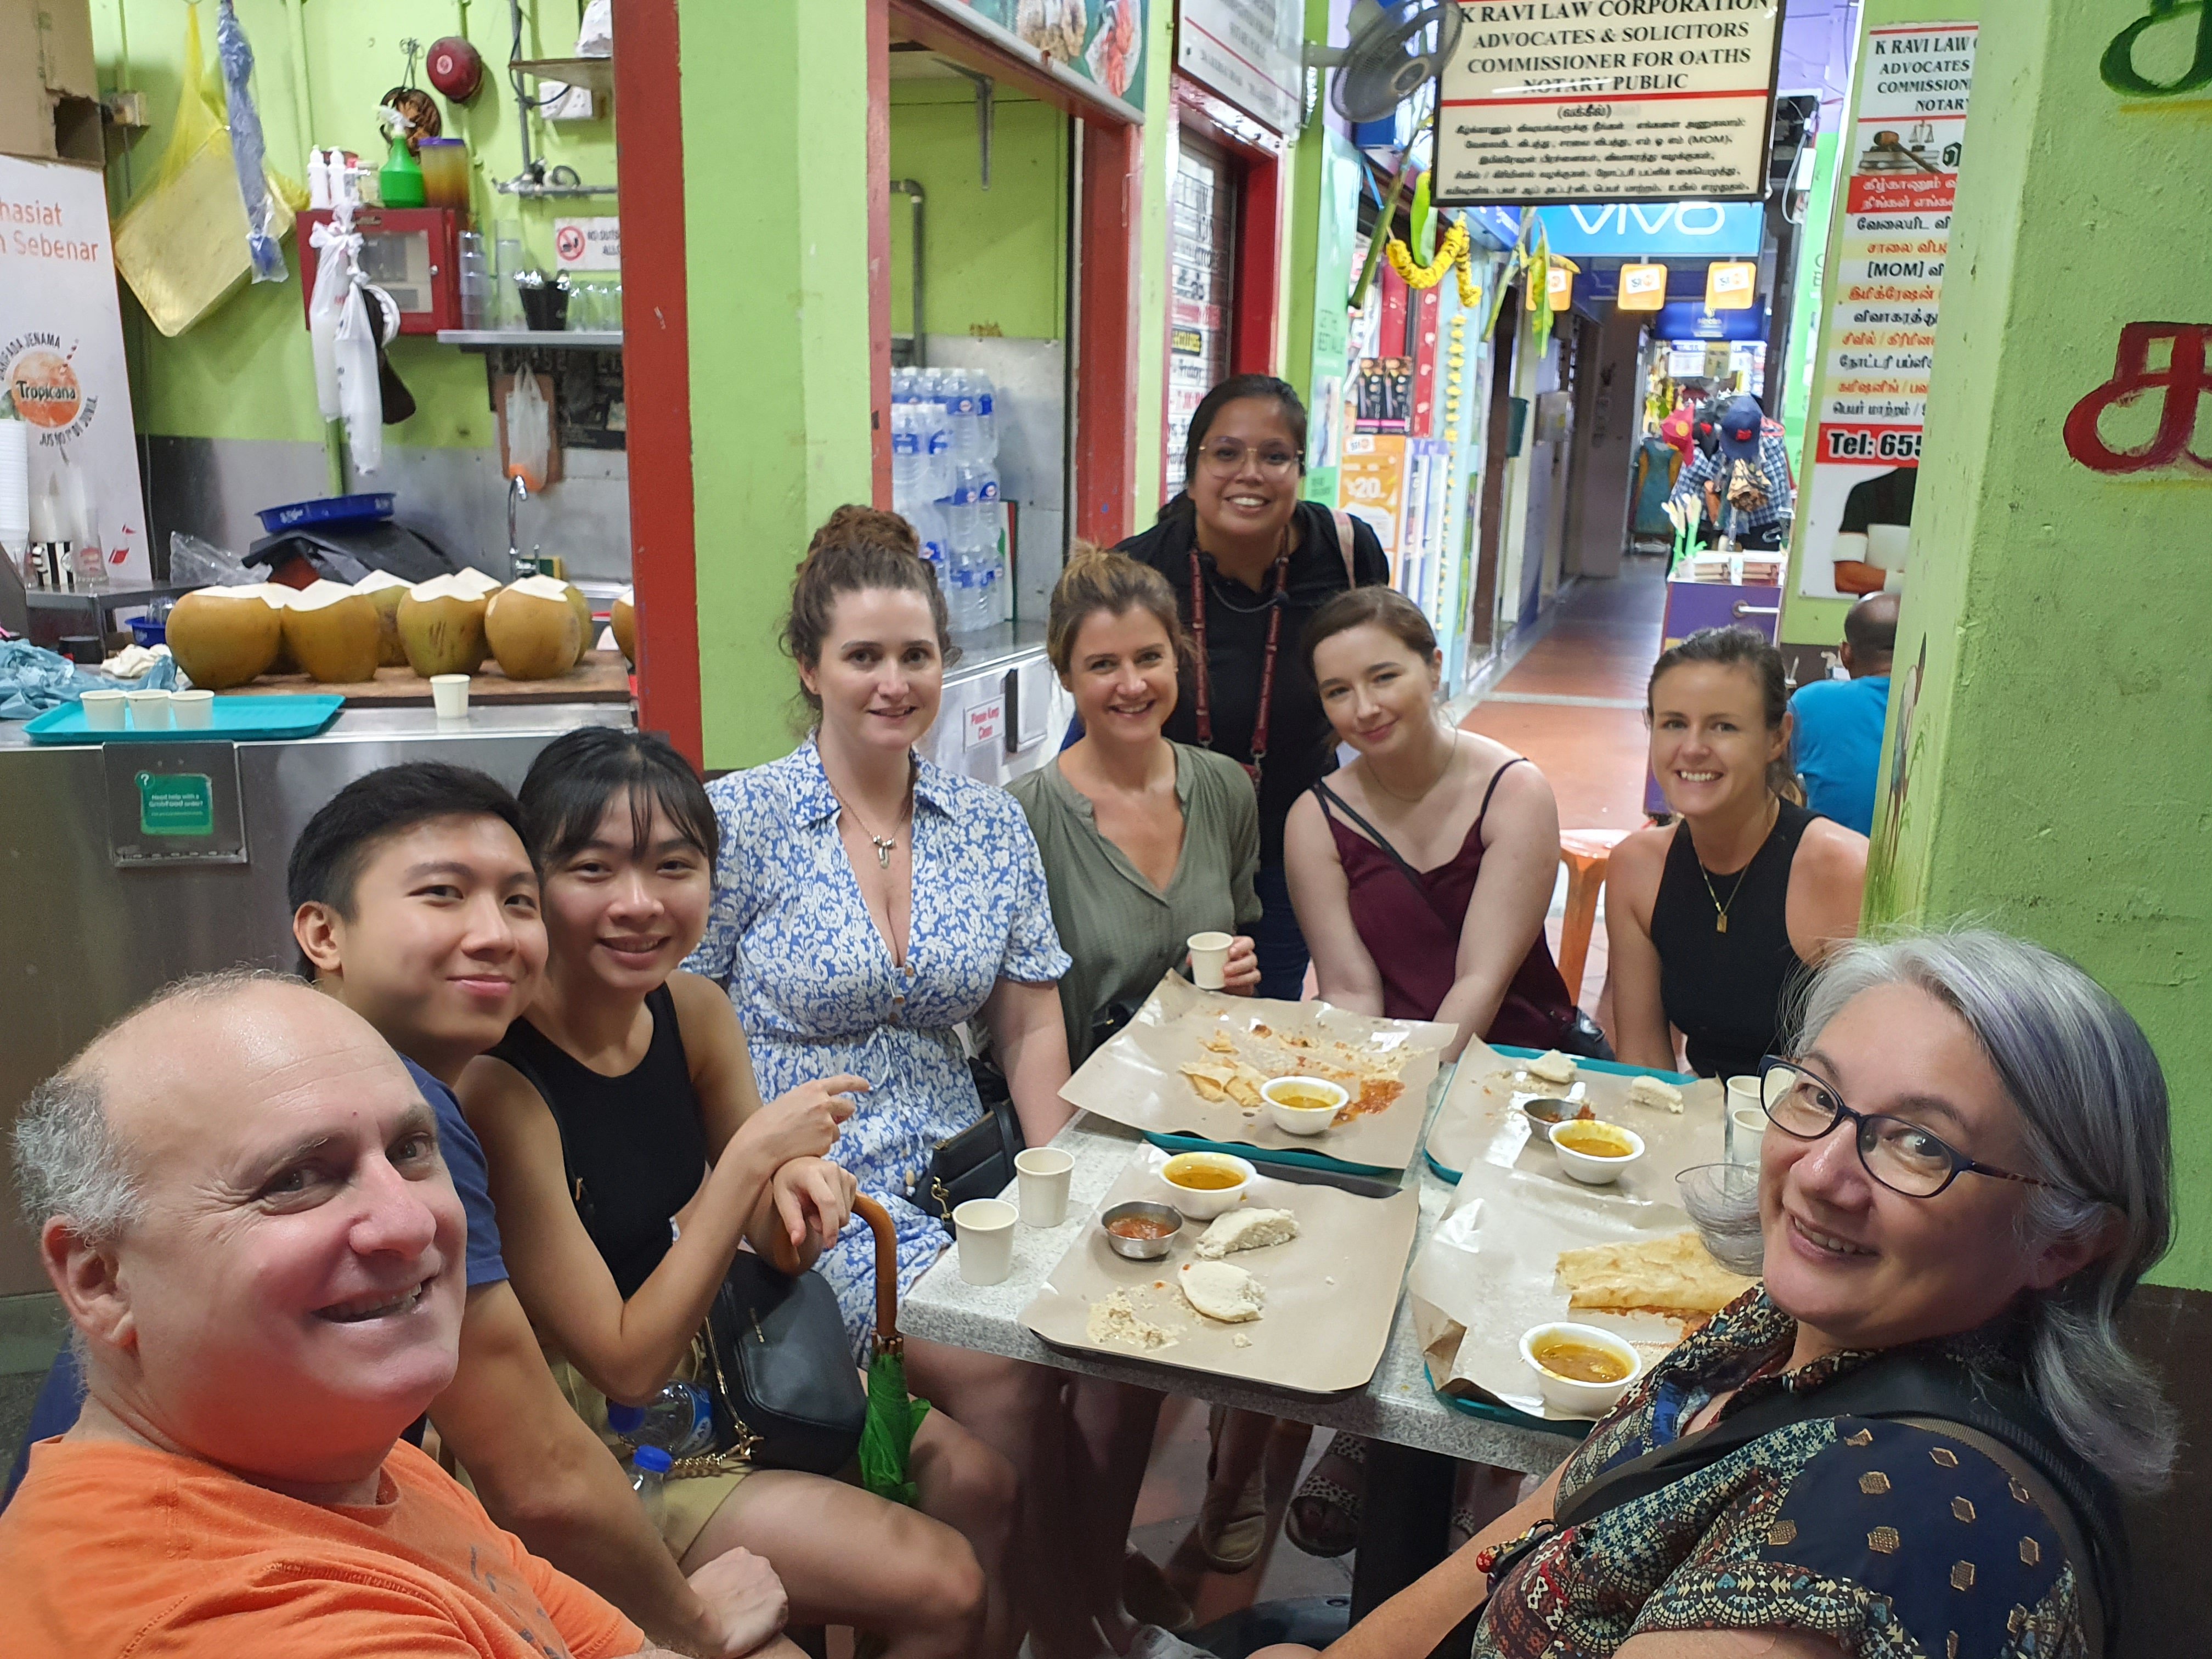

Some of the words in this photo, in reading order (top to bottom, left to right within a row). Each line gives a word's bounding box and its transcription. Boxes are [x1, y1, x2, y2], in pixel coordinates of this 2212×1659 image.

[1481, 4, 1535, 22] RAVI
[1542, 2, 1593, 20] LAW
[1598, 0, 1769, 17] CORPORATION
[1472, 29, 1595, 48] ADVOCATES
[1600, 27, 1616, 43] &
[1622, 21, 1750, 42] SOLICITORS
[1875, 40, 1886, 55] K
[1892, 38, 1928, 54] RAVI
[1933, 36, 1970, 52] LAW
[1468, 53, 1626, 74] COMMISSIONER
[1632, 51, 1673, 67] FOR
[1679, 48, 1752, 65] OATHS
[1878, 59, 1971, 75] ADVOCATES
[1522, 77, 1611, 94] NOTARY
[1613, 74, 1689, 91] PUBLIC
[1877, 78, 1971, 94] COMMISSION
[13, 229, 99, 263] Sebenar
[1867, 261, 1925, 279] [MOM]
[15, 380, 76, 402] Tropicana
[1830, 432, 1874, 456] Tel:
